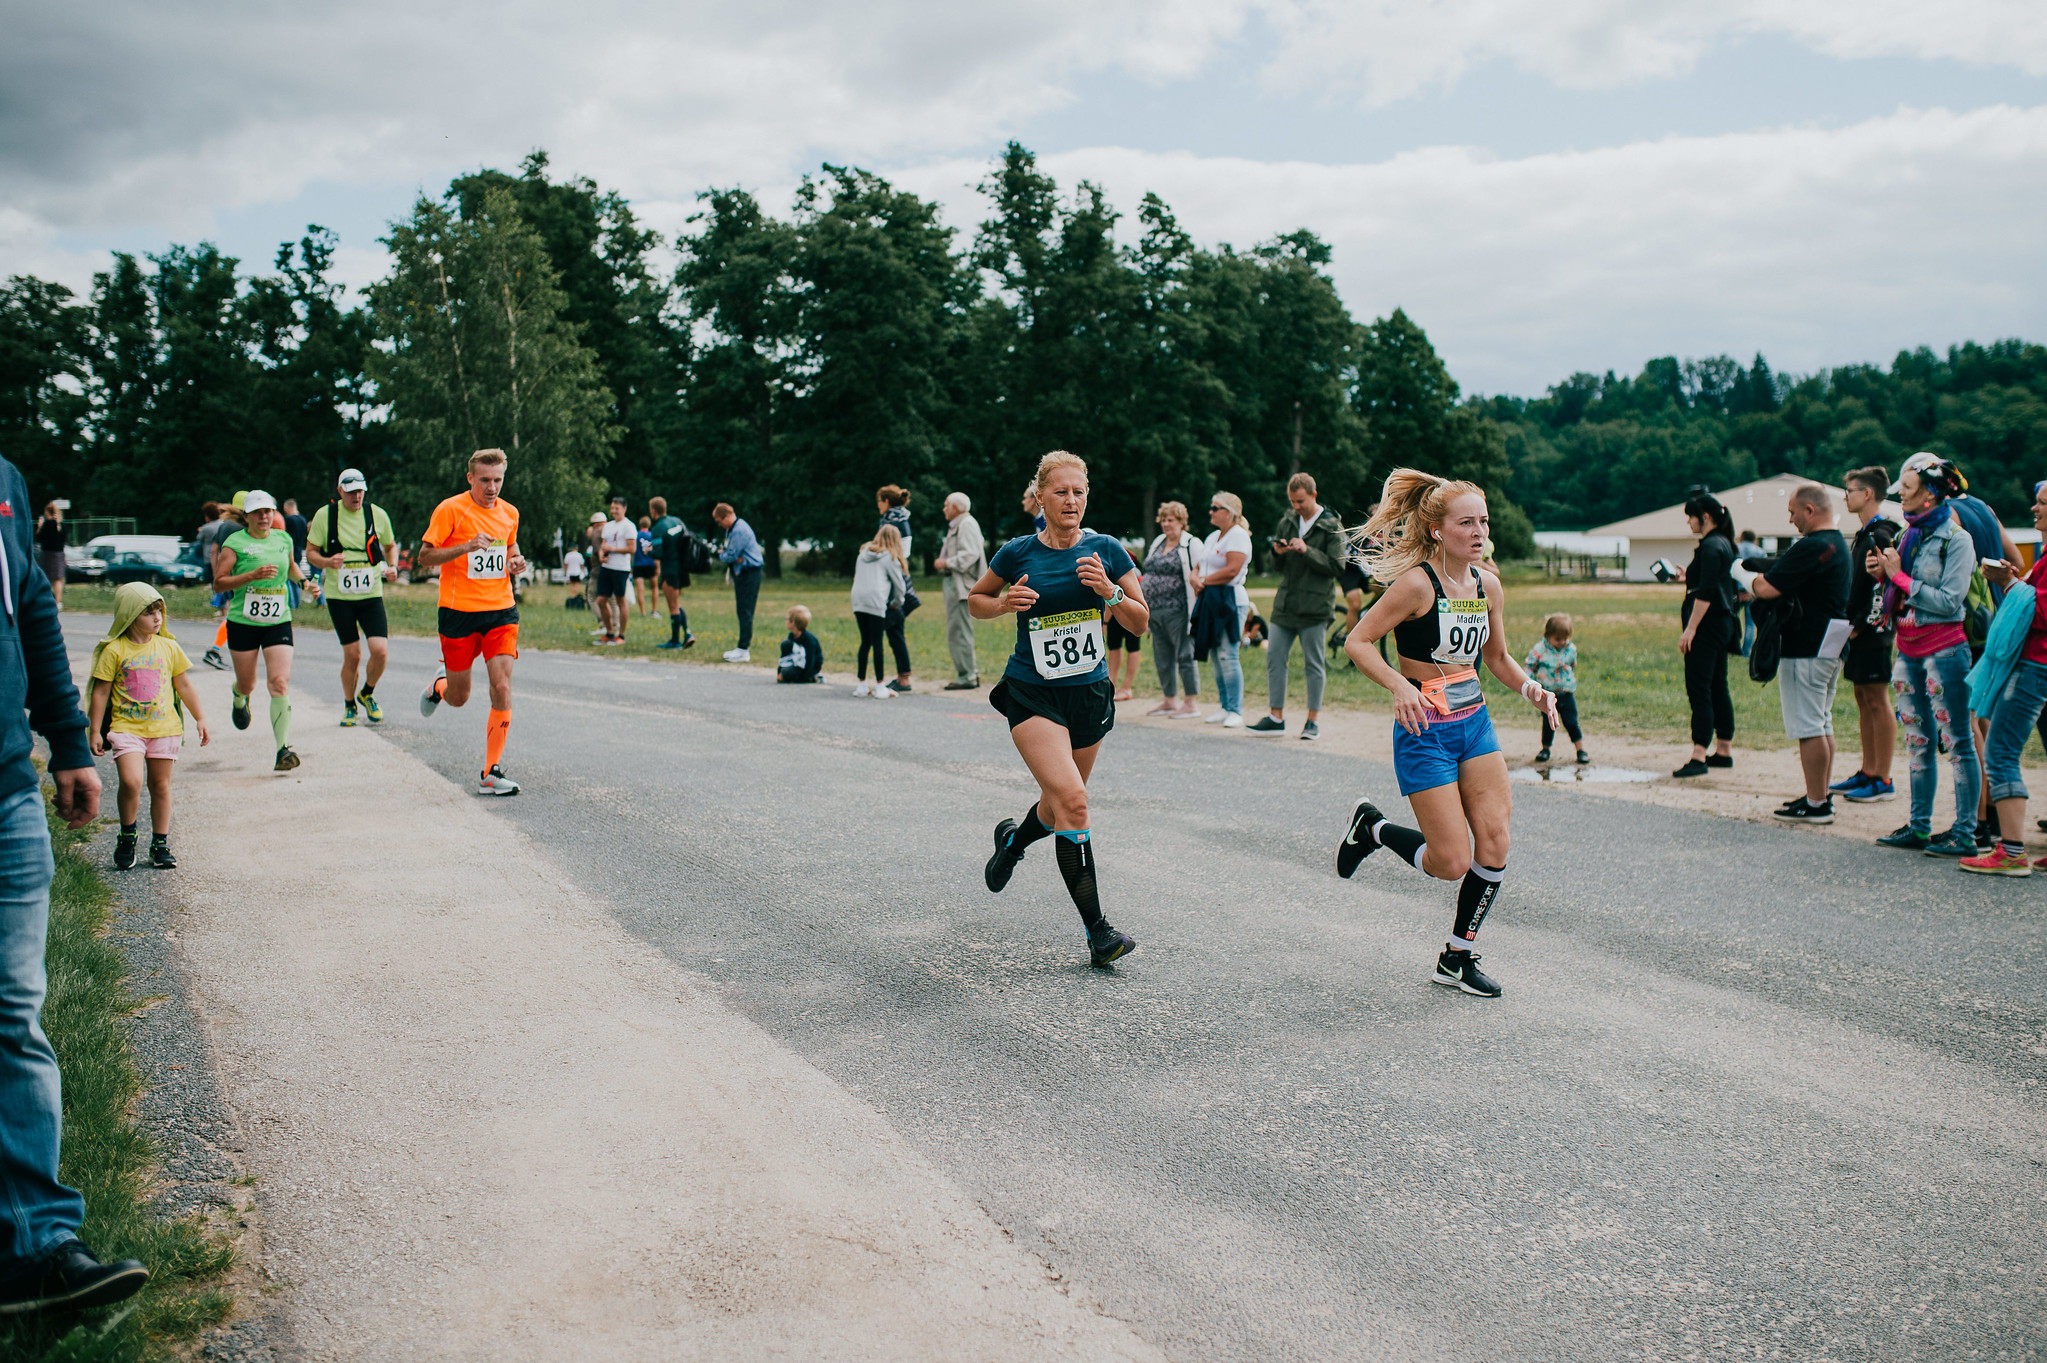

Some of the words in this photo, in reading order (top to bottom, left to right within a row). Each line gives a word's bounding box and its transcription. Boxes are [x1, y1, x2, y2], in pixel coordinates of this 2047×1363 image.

[474, 555, 504, 572] 340
[343, 574, 371, 588] 614
[250, 601, 280, 617] 832
[1043, 611, 1093, 624] SUURJOOKS
[1053, 624, 1082, 637] Kristel
[1448, 625, 1488, 655] 900
[1044, 633, 1097, 668] 584
